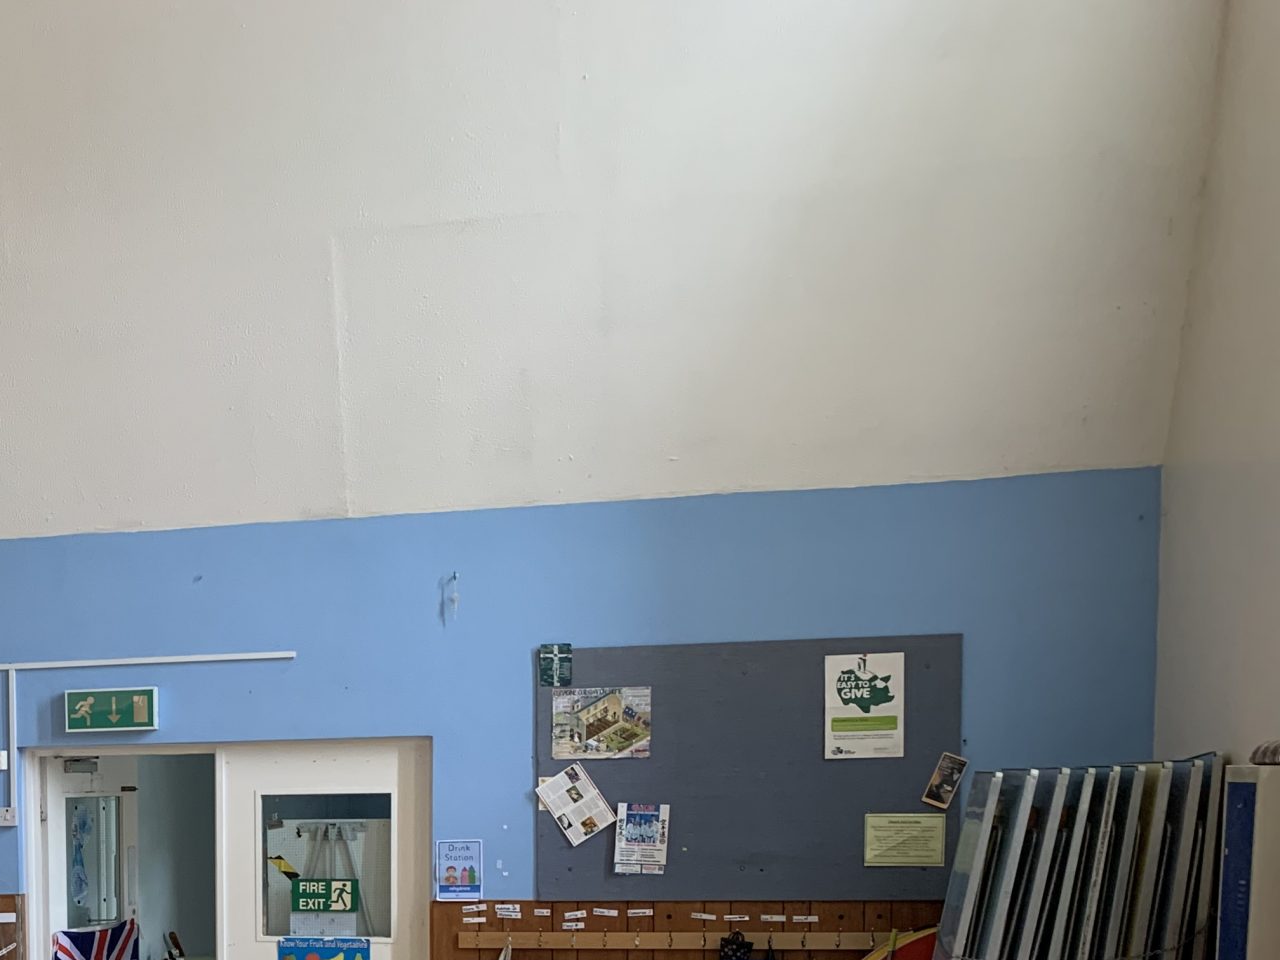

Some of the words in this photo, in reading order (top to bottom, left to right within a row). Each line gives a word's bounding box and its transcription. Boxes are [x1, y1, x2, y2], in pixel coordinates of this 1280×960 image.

[837, 681, 856, 689] EASY
[858, 680, 870, 688] TO
[841, 687, 871, 699] GIVE
[448, 844, 471, 852] Drink
[444, 853, 474, 861] Station
[299, 882, 327, 894] FIRE
[299, 898, 326, 910] EXIT
[280, 940, 297, 948] Know
[309, 939, 324, 948] Fruit
[324, 940, 336, 948] and
